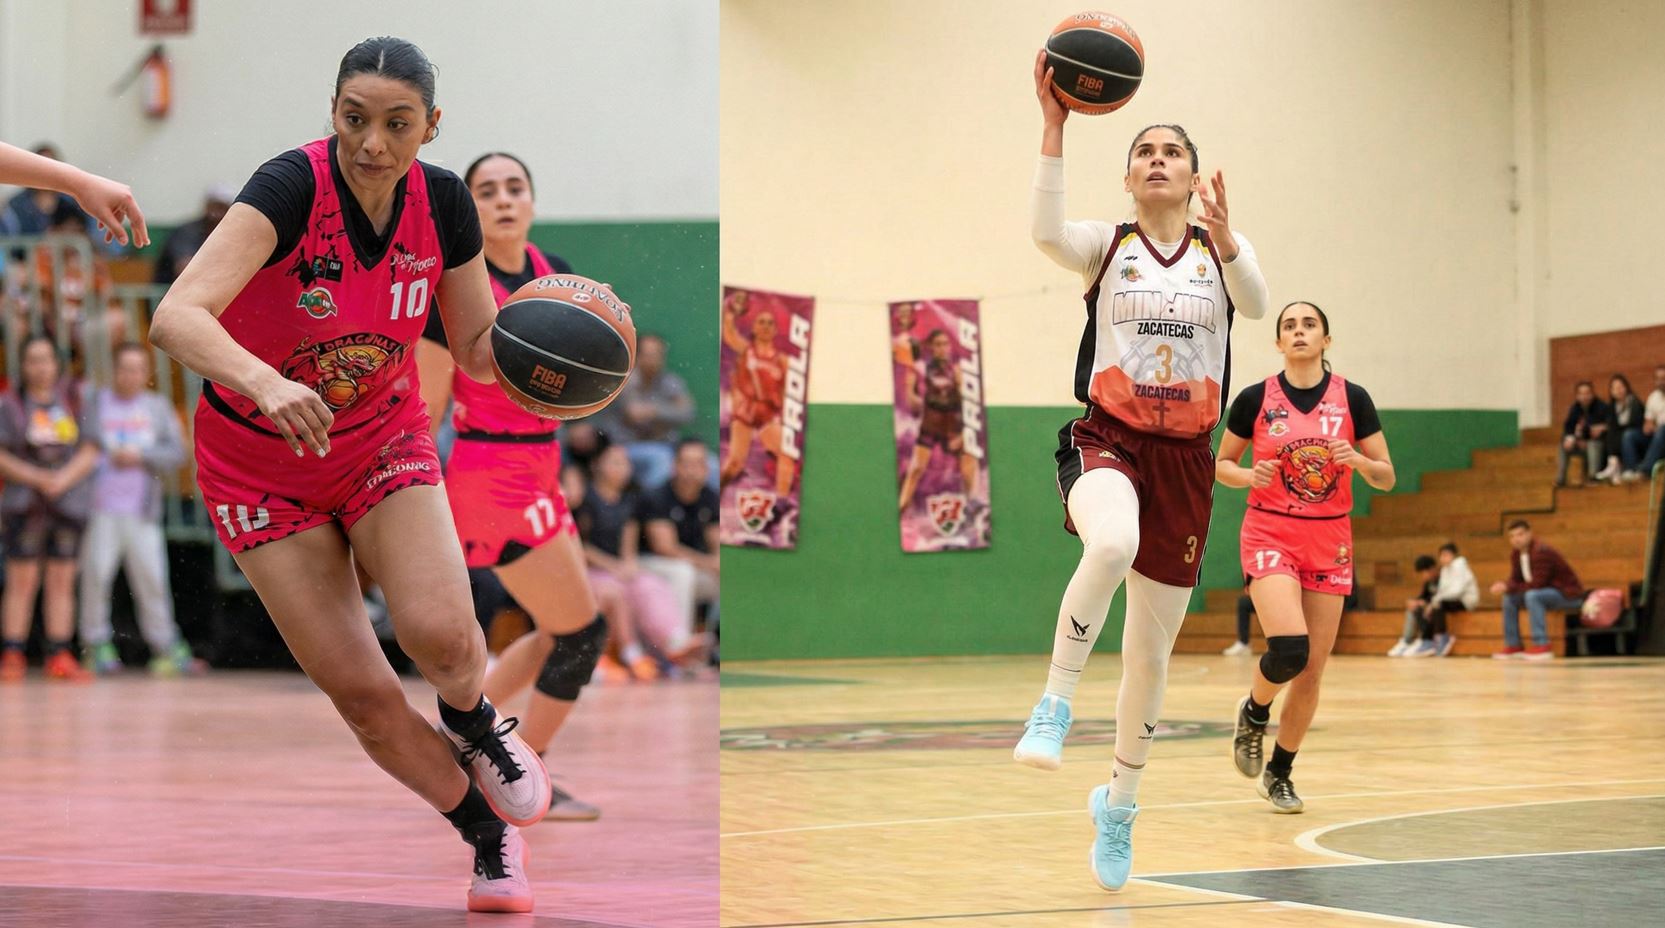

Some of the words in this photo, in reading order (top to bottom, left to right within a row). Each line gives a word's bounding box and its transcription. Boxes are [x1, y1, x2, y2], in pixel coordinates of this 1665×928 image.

[390, 278, 429, 320] 10
[1137, 322, 1194, 339] ZACATECAS
[532, 364, 567, 389] FIBA
[1155, 344, 1173, 384] 3
[1134, 384, 1191, 402] ZACATECAS
[1319, 416, 1344, 437] 17
[524, 498, 556, 537] 17
[1184, 535, 1198, 564] 3
[1256, 550, 1281, 571] 17
